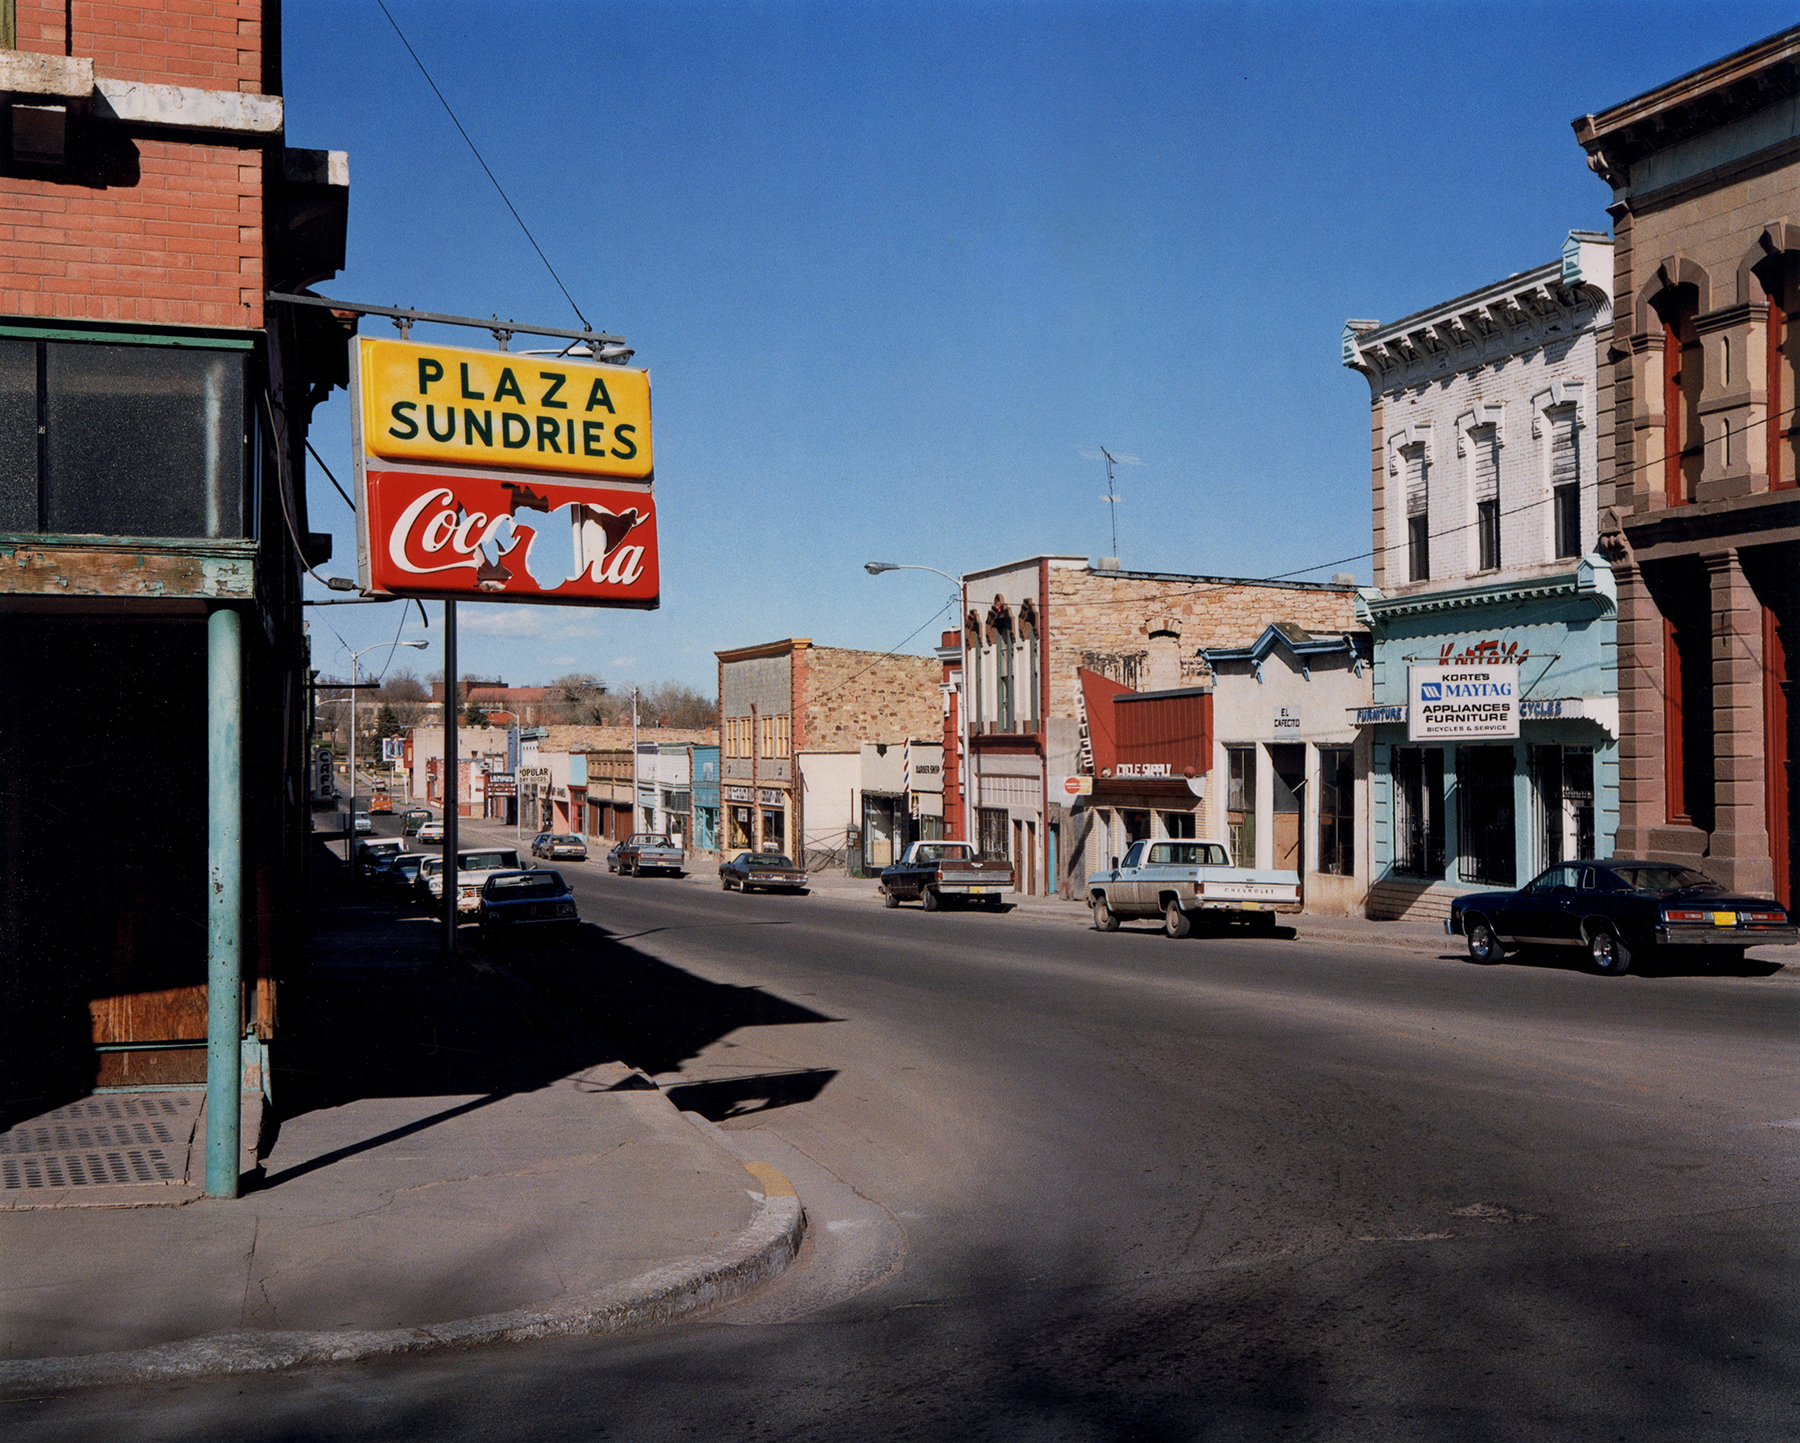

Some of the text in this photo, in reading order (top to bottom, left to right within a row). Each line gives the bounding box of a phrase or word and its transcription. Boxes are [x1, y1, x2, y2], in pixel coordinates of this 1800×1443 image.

[417, 357, 616, 415] PLAZA
[388, 401, 638, 460] SUNDRIES
[1442, 672, 1490, 682] KORTE'S
[1445, 682, 1511, 697] MAYTAG
[1281, 708, 1289, 717] EL
[1357, 707, 1402, 723] FURNITURE
[1422, 703, 1510, 714] APPLIANCES
[1519, 701, 1562, 718] CYCLES
[1425, 713, 1508, 723] FURNITURE
[319, 751, 331, 796] CAFE
